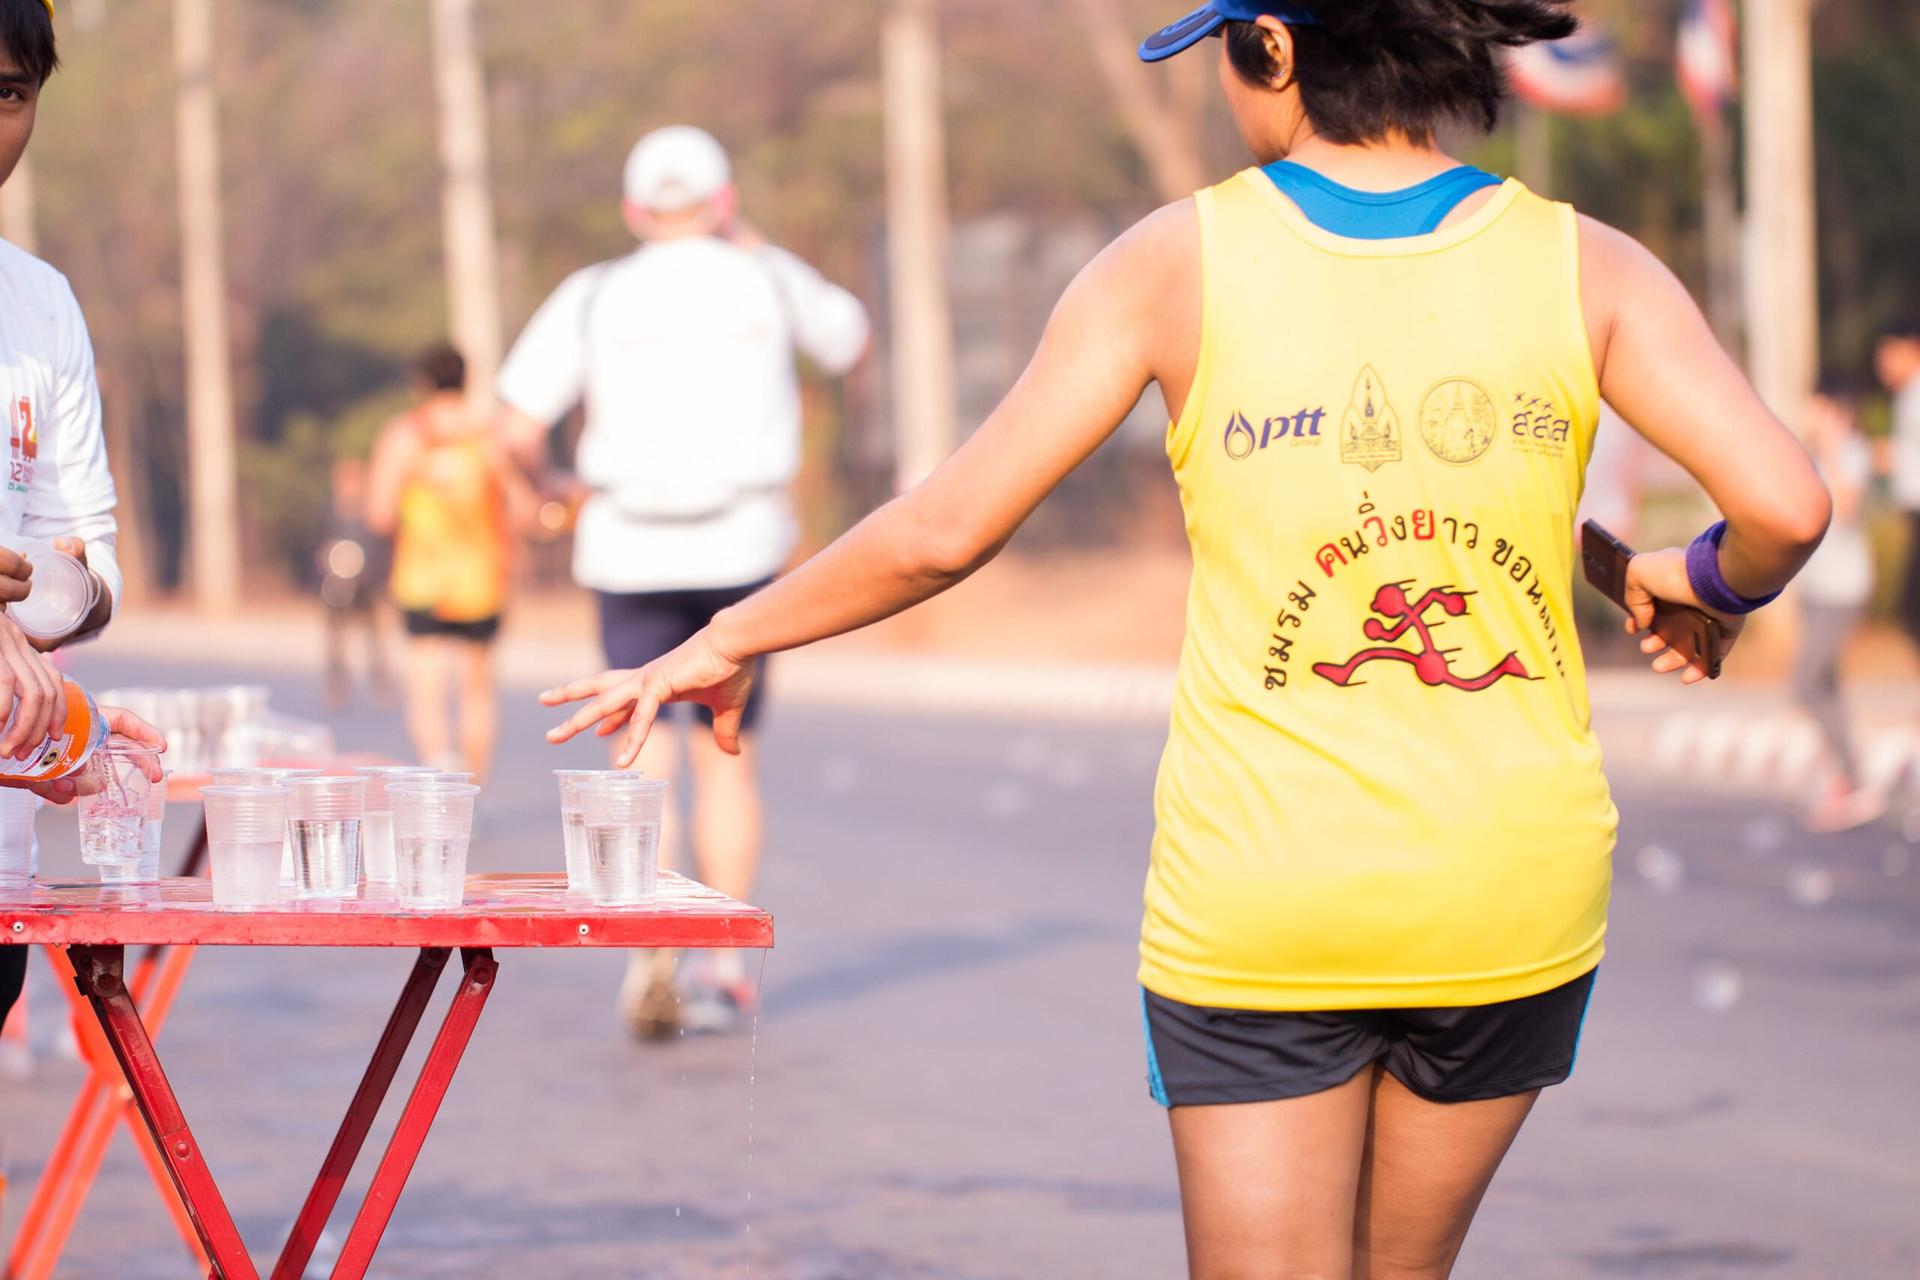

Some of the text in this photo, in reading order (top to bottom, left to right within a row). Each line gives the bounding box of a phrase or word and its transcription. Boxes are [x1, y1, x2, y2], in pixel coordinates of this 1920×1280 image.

[1260, 405, 1327, 449] ptt
[1264, 580, 1316, 690] ชมรม
[1315, 491, 1478, 578] คนวิ่งยาว
